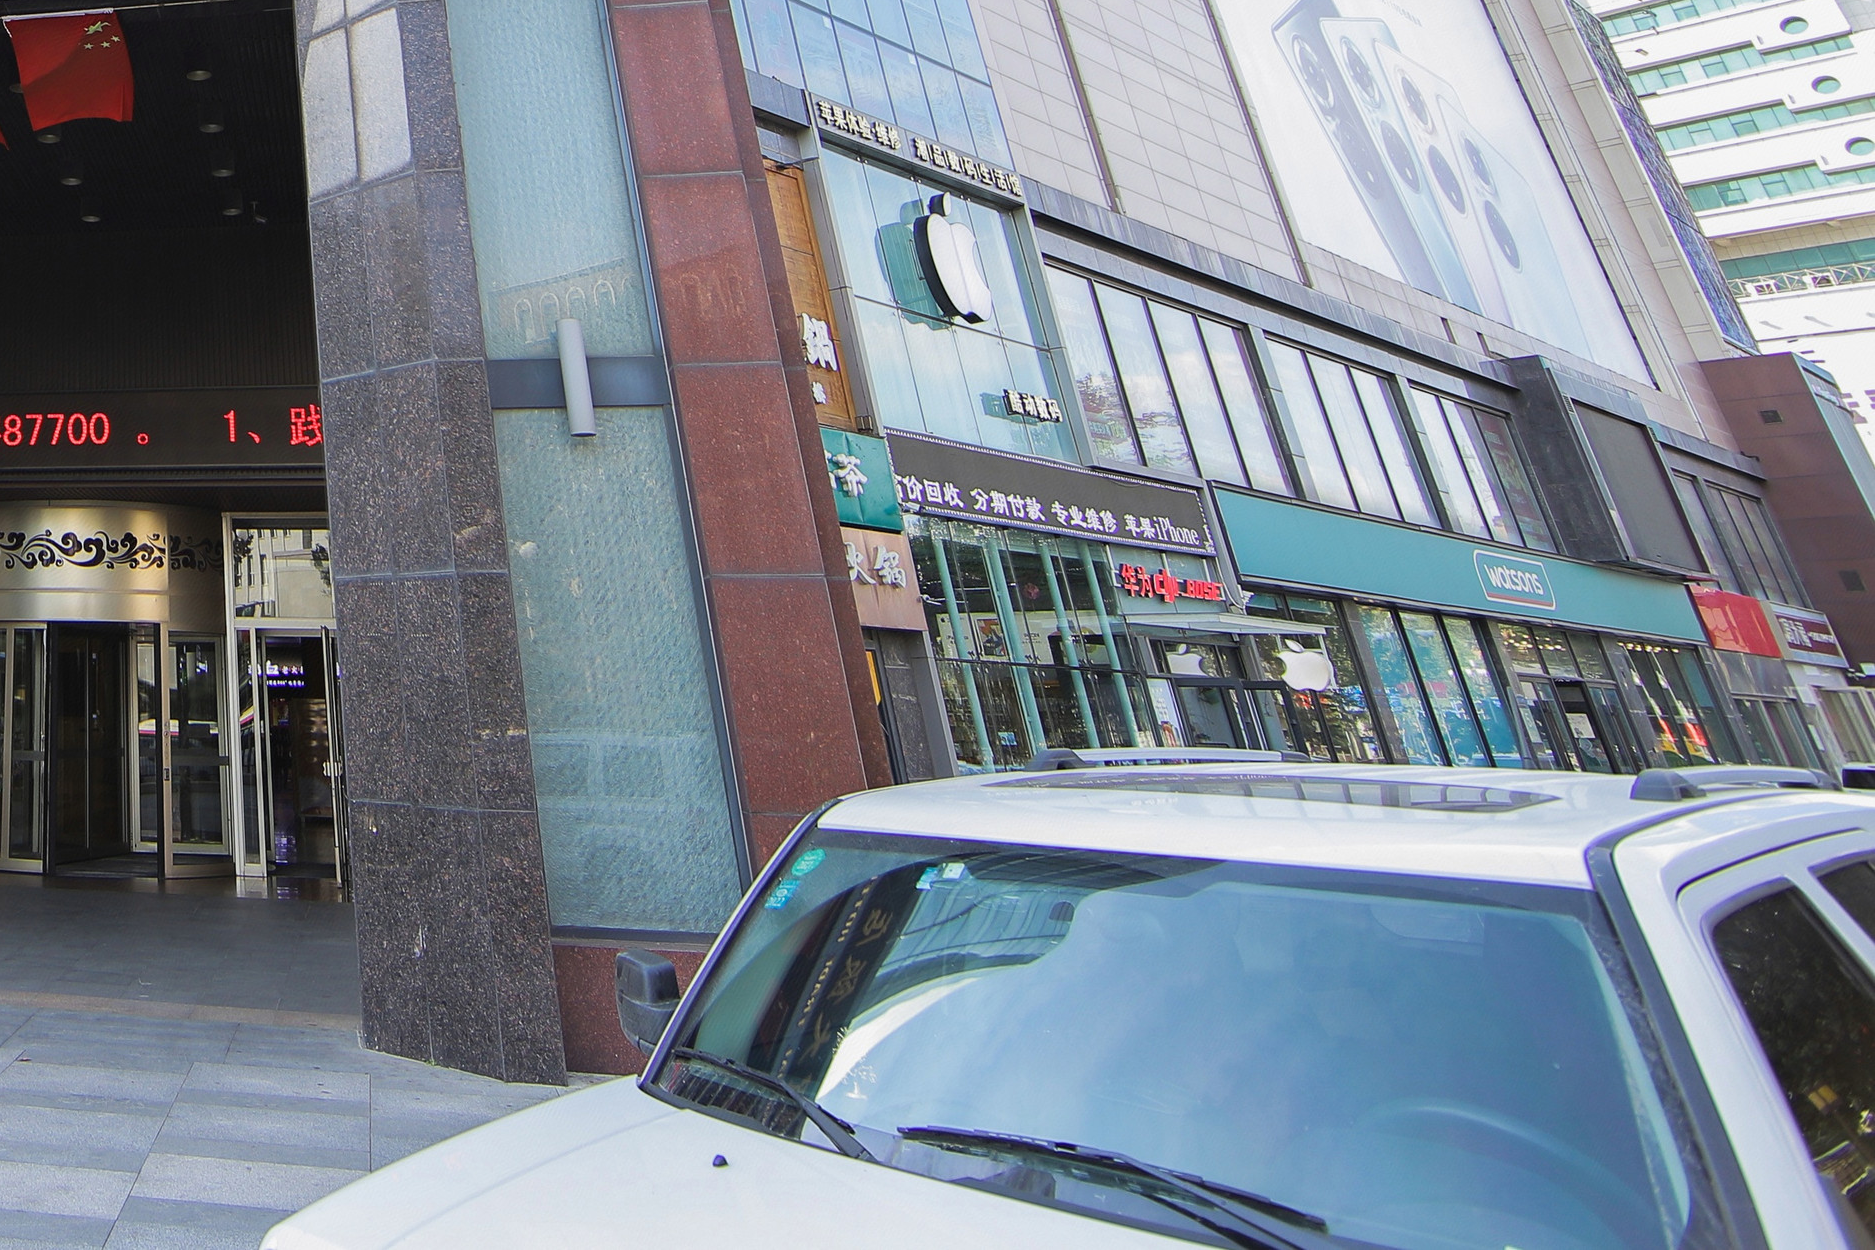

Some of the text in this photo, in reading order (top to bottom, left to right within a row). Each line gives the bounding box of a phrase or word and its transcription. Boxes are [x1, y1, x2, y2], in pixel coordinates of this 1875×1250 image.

[825, 451, 869, 498] 茶
[970, 487, 1047, 523] 分期付款
[1051, 500, 1119, 534] 专业维修
[1483, 563, 1545, 596] watsons
